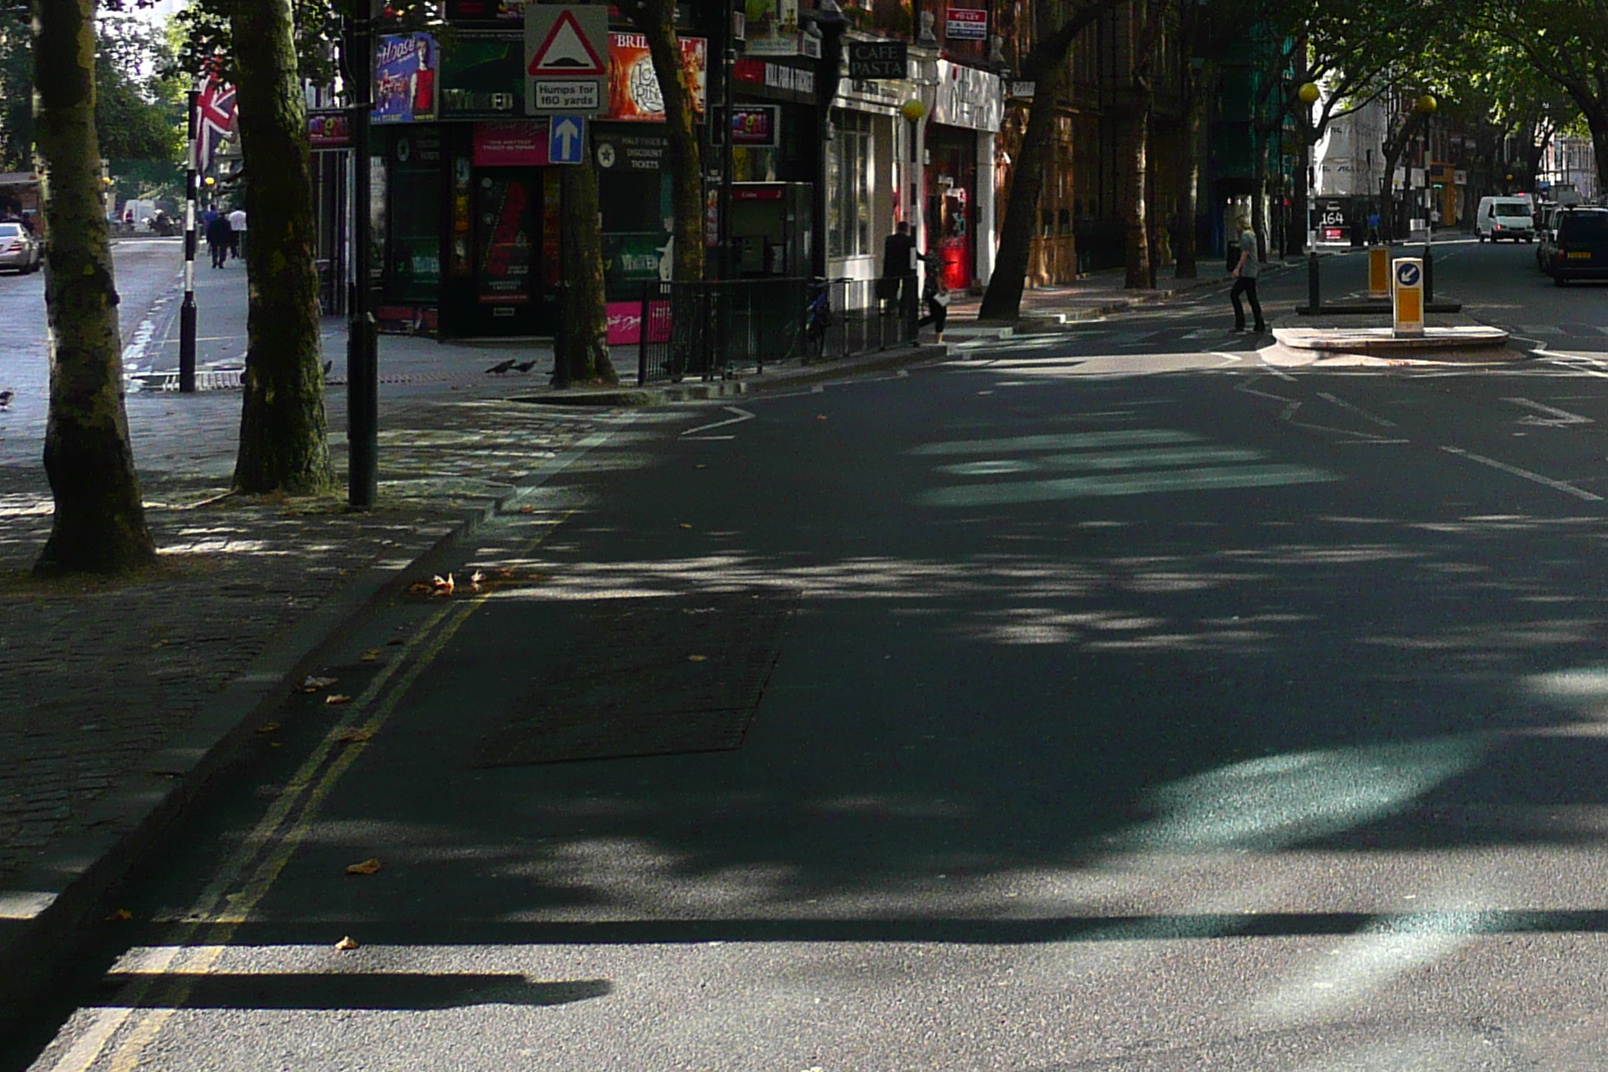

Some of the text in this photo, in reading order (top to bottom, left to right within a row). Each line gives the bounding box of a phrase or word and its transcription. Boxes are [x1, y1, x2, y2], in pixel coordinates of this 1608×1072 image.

[856, 46, 898, 59] CAFE
[851, 61, 903, 75] PASTA
[540, 84, 595, 96] Humps for
[542, 94, 593, 106] 160 yards
[631, 160, 659, 169] TICKETS
[1322, 212, 1344, 225] 164
